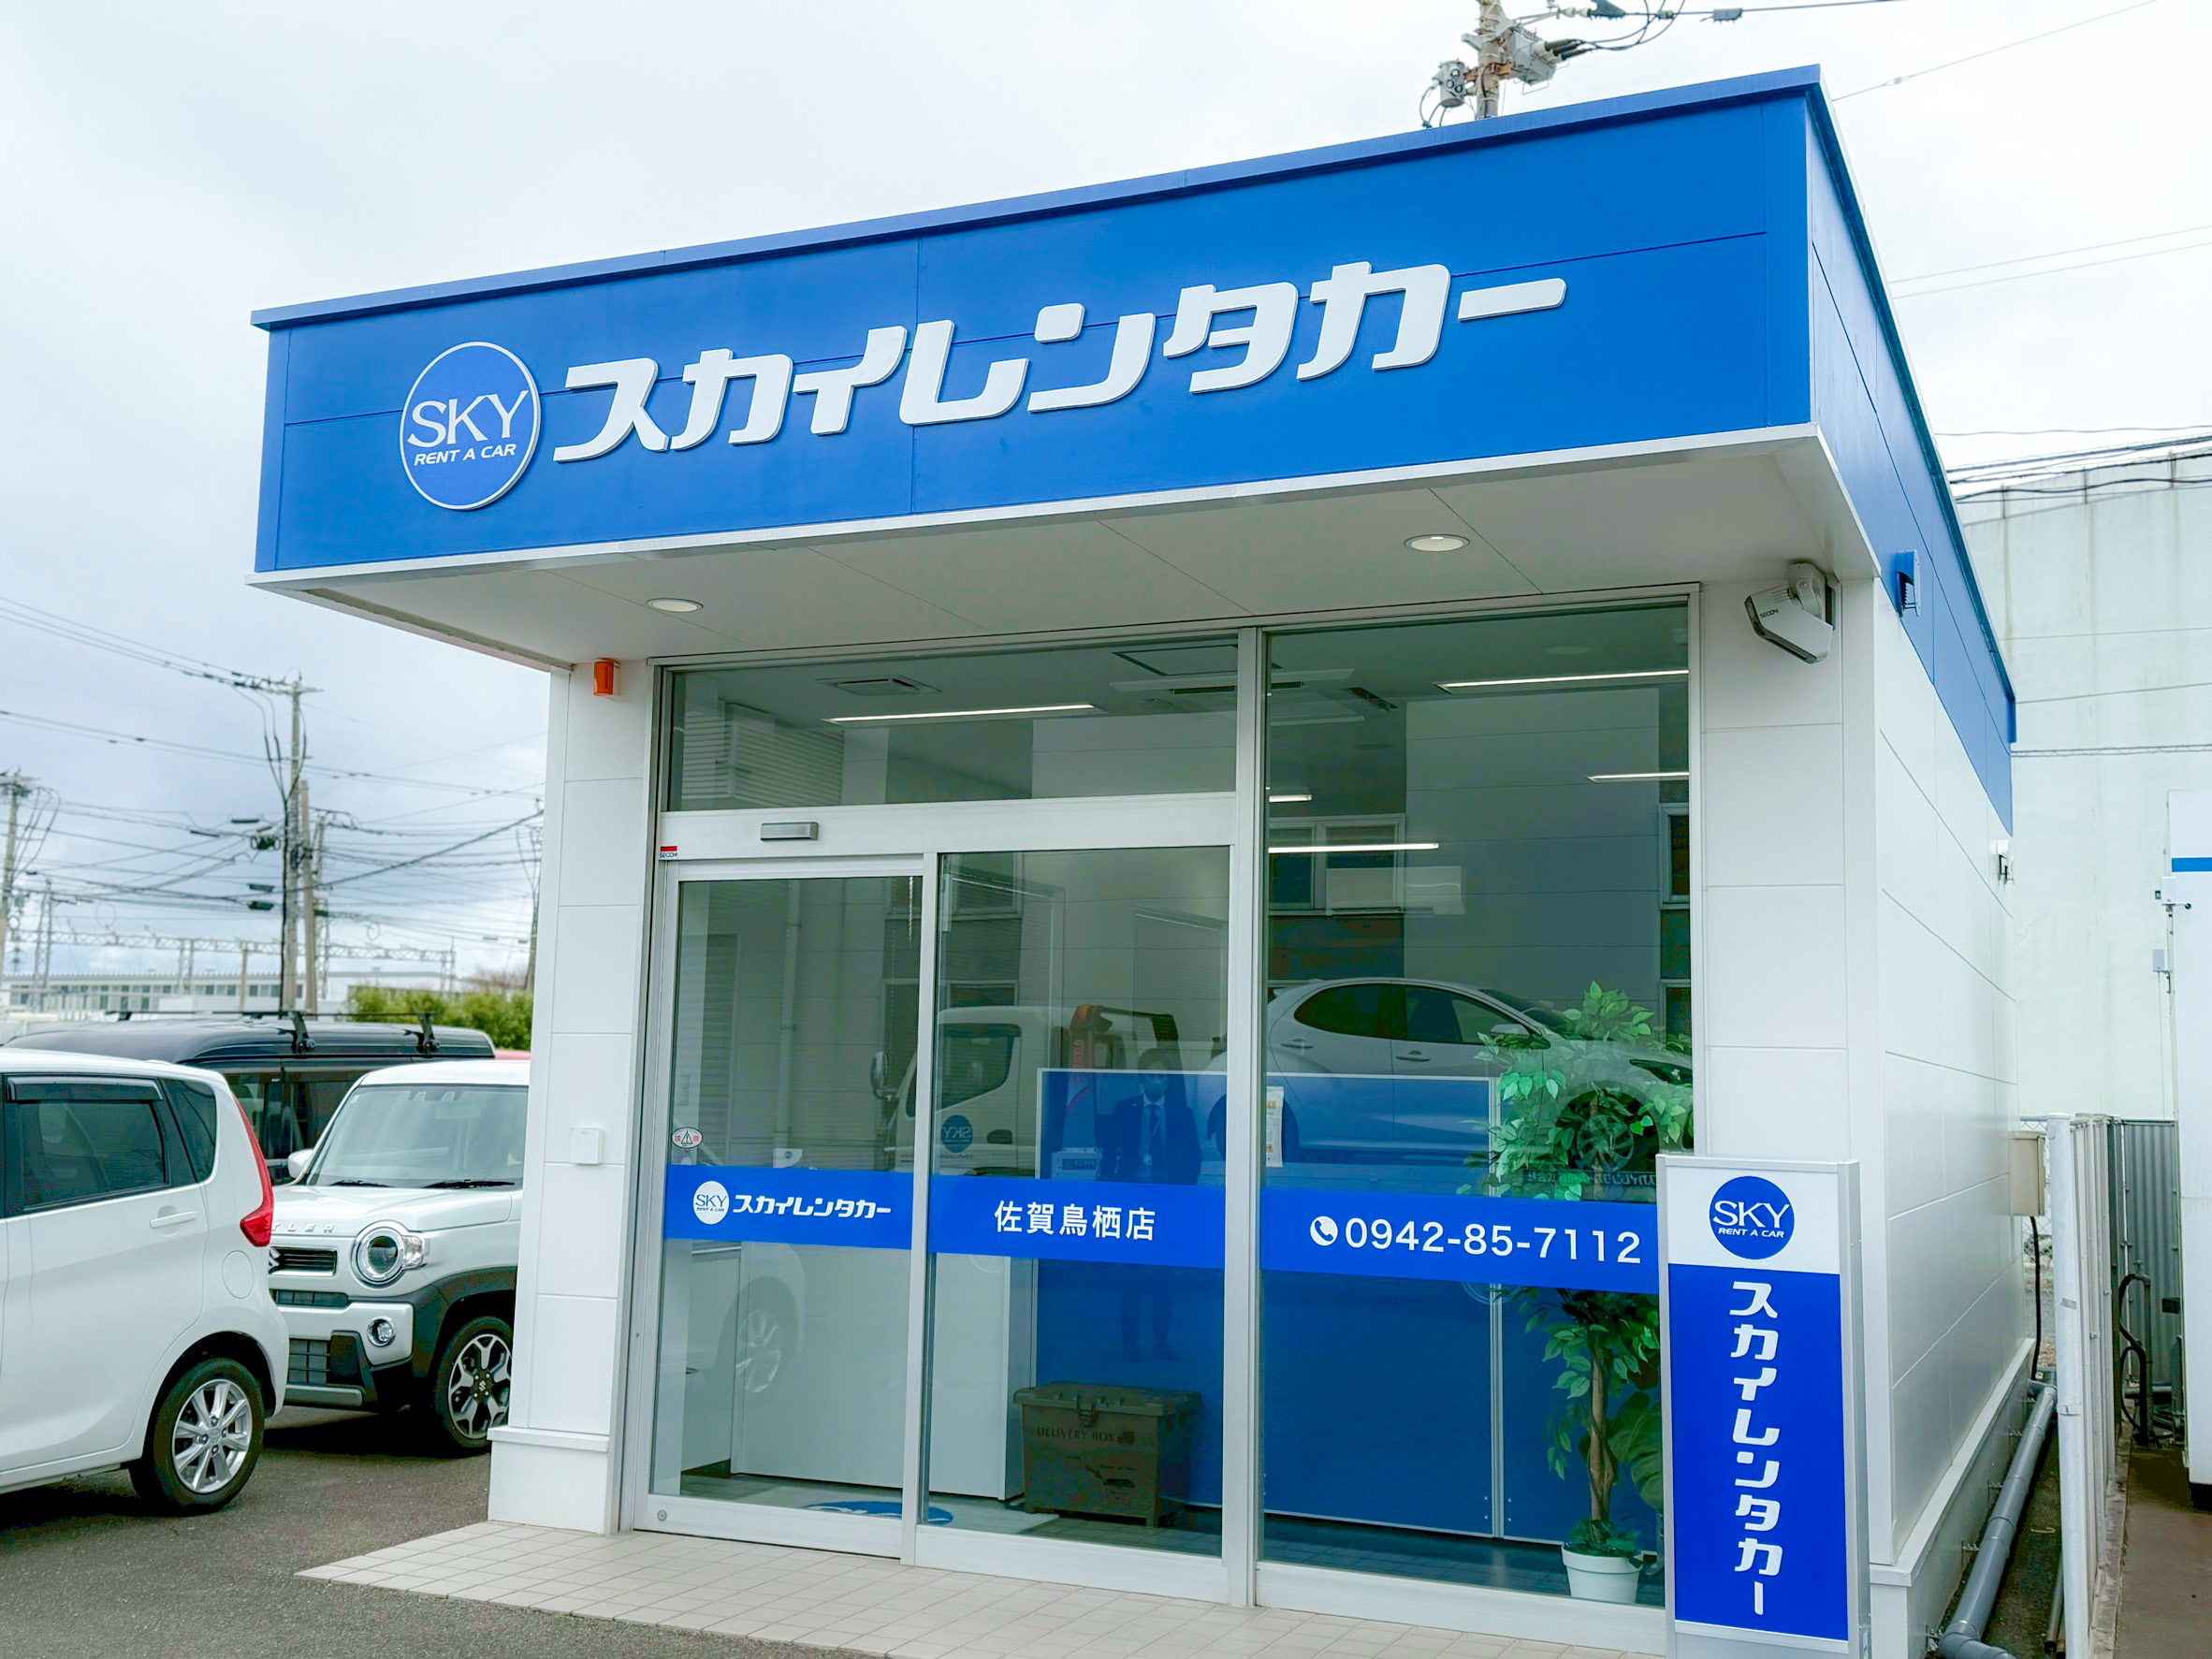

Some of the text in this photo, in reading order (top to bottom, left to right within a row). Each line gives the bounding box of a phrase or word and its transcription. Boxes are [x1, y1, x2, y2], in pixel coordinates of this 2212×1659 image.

[553, 261, 1567, 462] スカイレンタカー
[407, 389, 529, 448] SKY
[414, 443, 517, 466] RENT A CAR
[695, 1194, 727, 1207] SKY
[734, 1194, 891, 1219] スカイレンタカー
[1713, 1201, 1790, 1228] SKY
[995, 1201, 1156, 1241] 佐賀鳥栖店
[1346, 1217, 1641, 1263] 0942-85-7112
[1037, 1426, 1115, 1442] DELIVERY BOX
[1730, 1281, 1783, 1615] スカイレンタカー
